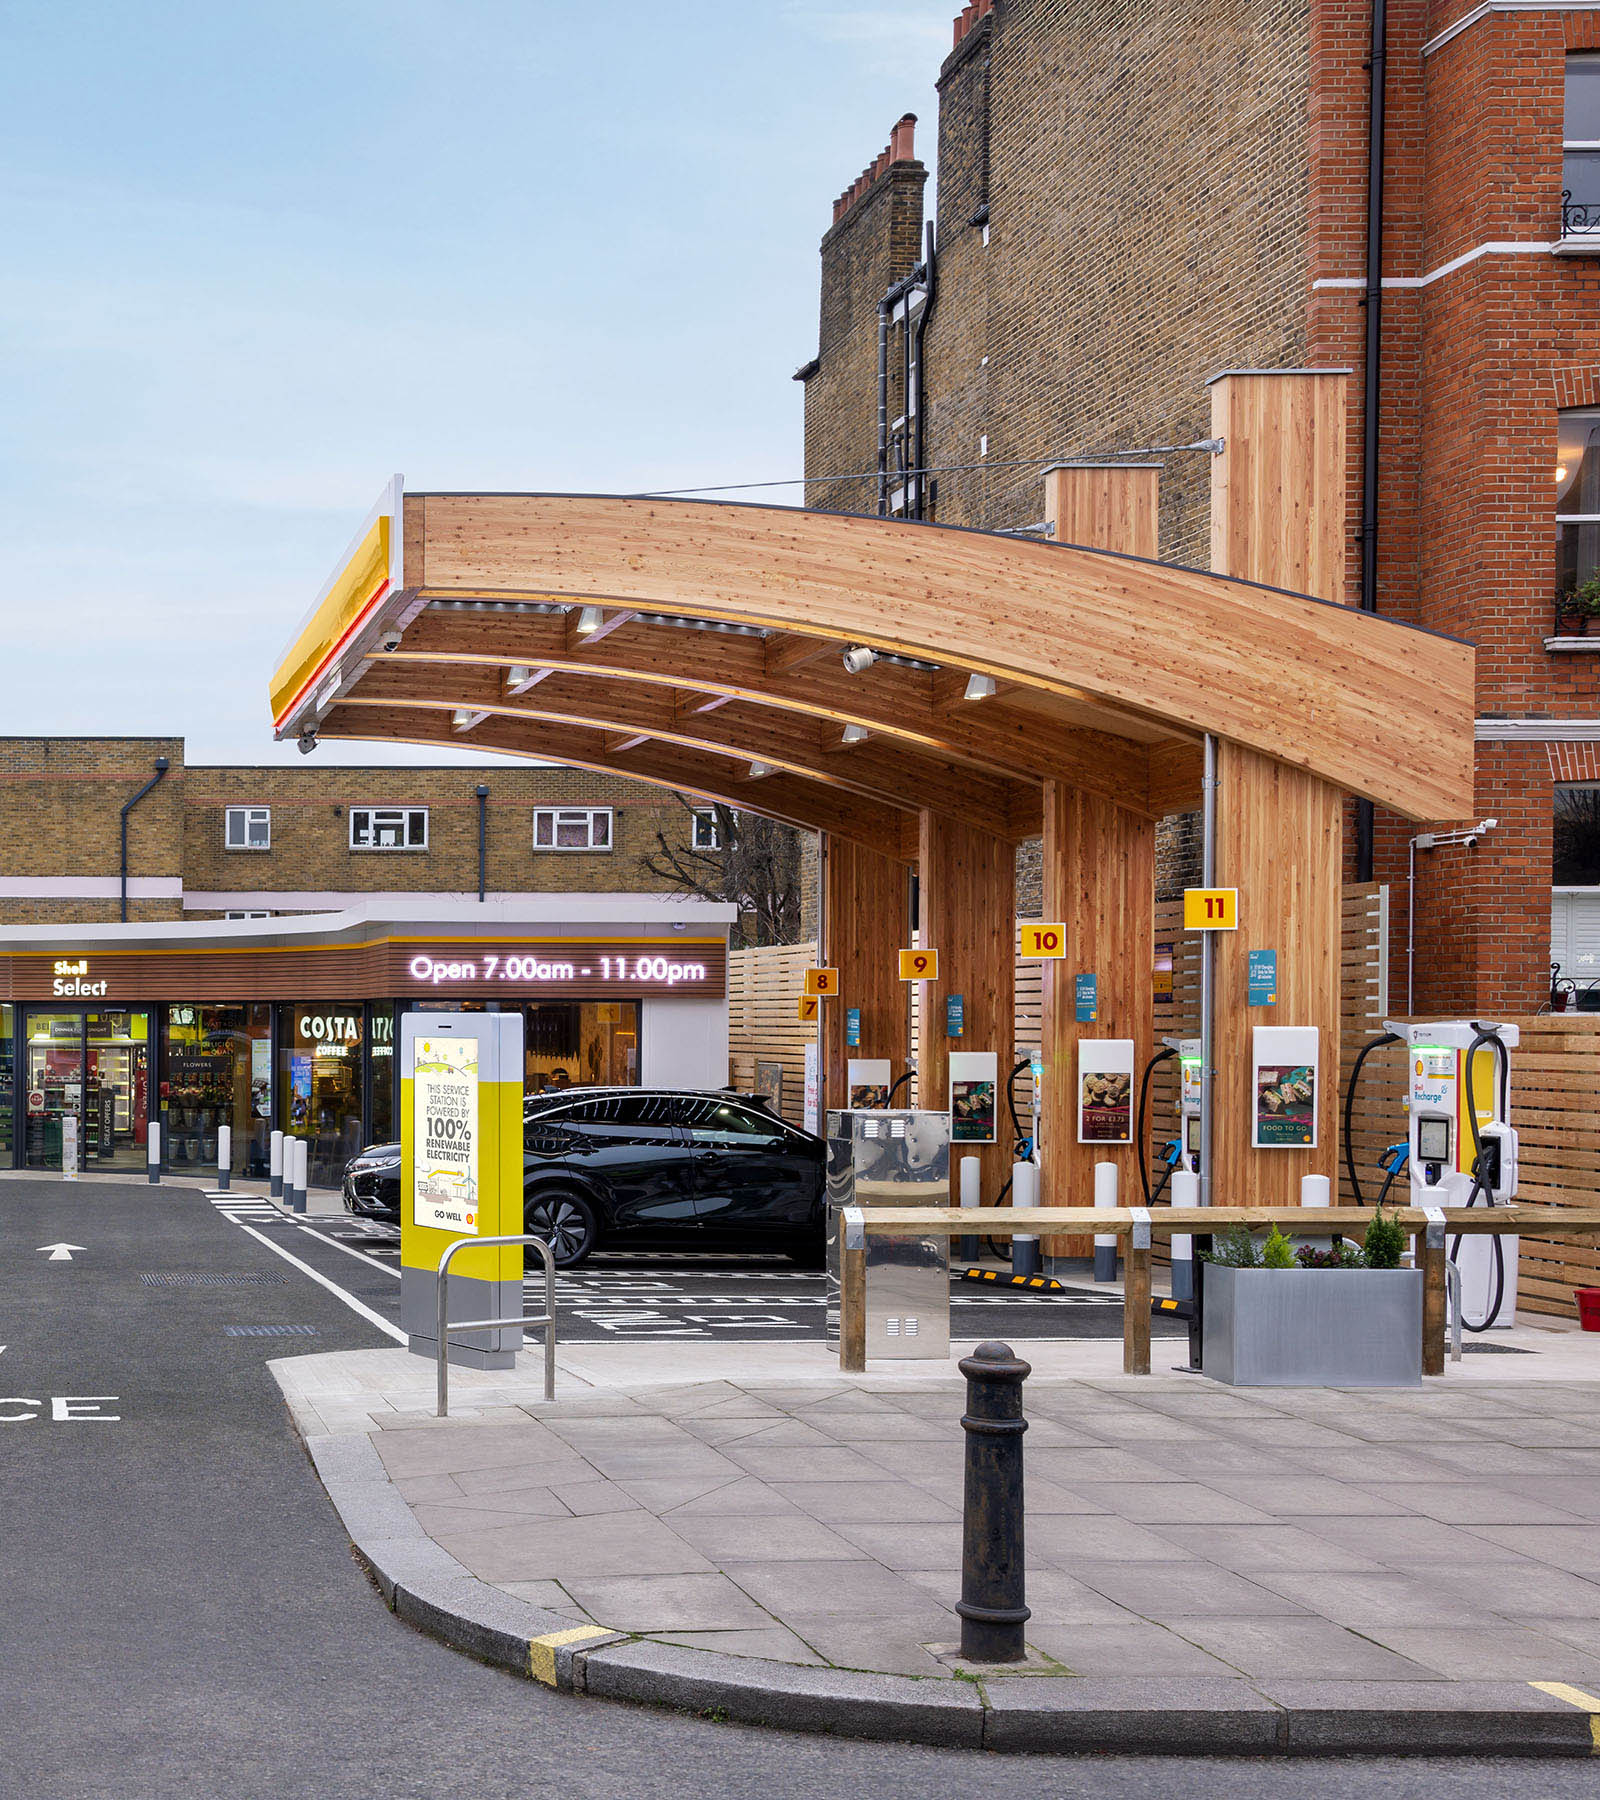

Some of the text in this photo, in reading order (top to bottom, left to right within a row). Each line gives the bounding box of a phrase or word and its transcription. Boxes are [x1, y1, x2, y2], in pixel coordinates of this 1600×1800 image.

[1204, 897, 1224, 919] 11
[1033, 932, 1058, 950] 10
[54, 960, 88, 975] Shell
[410, 956, 475, 984] Open
[483, 956, 574, 979] 7.00am
[600, 957, 705, 985] 11.00pm
[914, 957, 927, 973] 9
[53, 977, 108, 996] Select
[817, 974, 828, 989] 8
[805, 1002, 817, 1016] 7
[300, 1016, 358, 1042] COSTA
[315, 1046, 349, 1057] COFFEE
[427, 1083, 470, 1096] THIS SERVICE
[429, 1094, 467, 1107] STATION IS
[1414, 1091, 1442, 1103] Recharge
[426, 1105, 470, 1119] POWERED BY
[427, 1117, 471, 1141] 100%
[426, 1138, 471, 1152] RENEWABLE
[426, 1150, 470, 1164] ELECTRICITY
[434, 1209, 462, 1222] GO WELL
